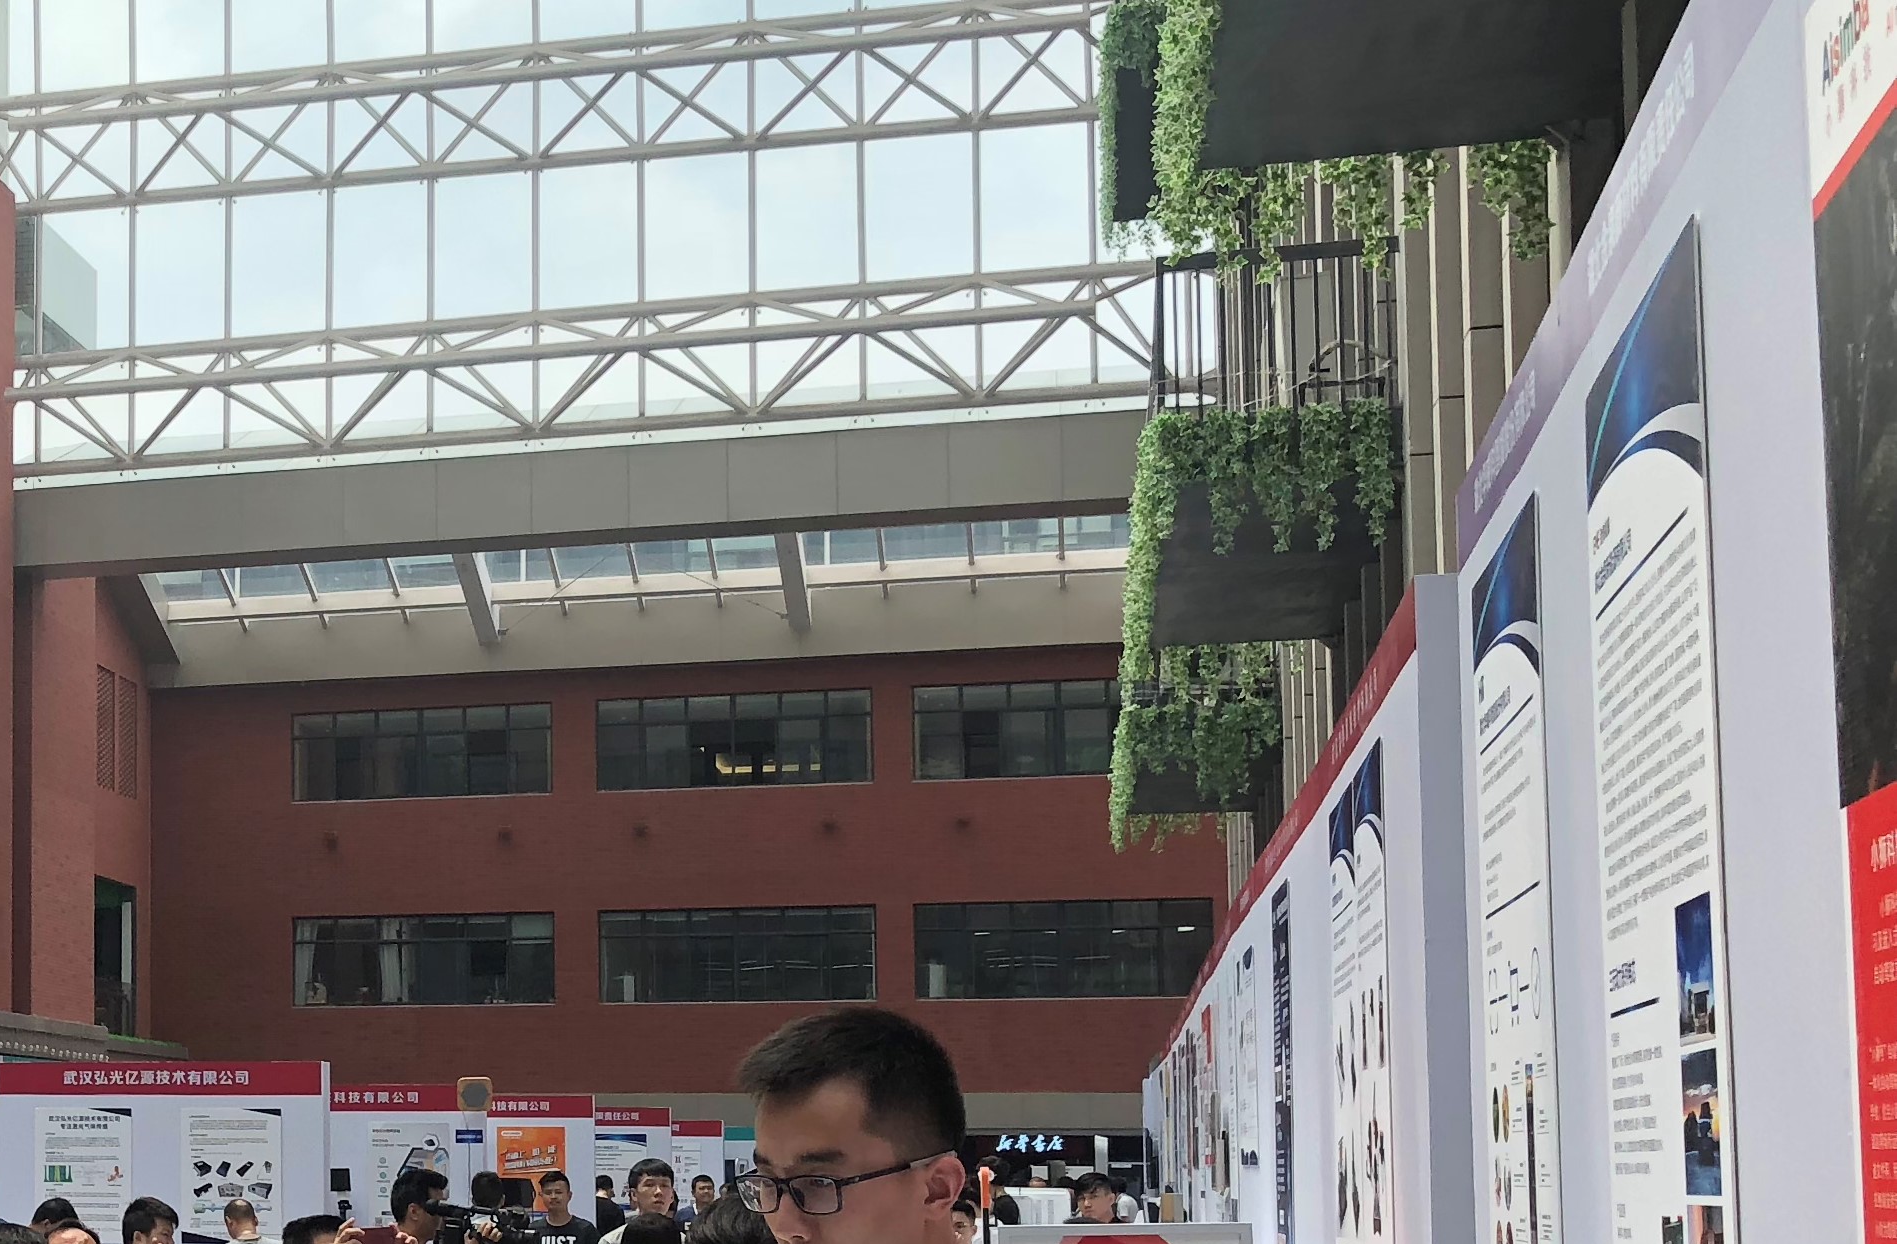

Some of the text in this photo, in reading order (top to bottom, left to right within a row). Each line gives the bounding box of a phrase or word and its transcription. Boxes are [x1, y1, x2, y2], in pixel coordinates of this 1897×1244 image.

[63, 1070, 250, 1086] 武汉弘光亿源技术有限公司
[331, 1092, 419, 1104] 科技有限公司
